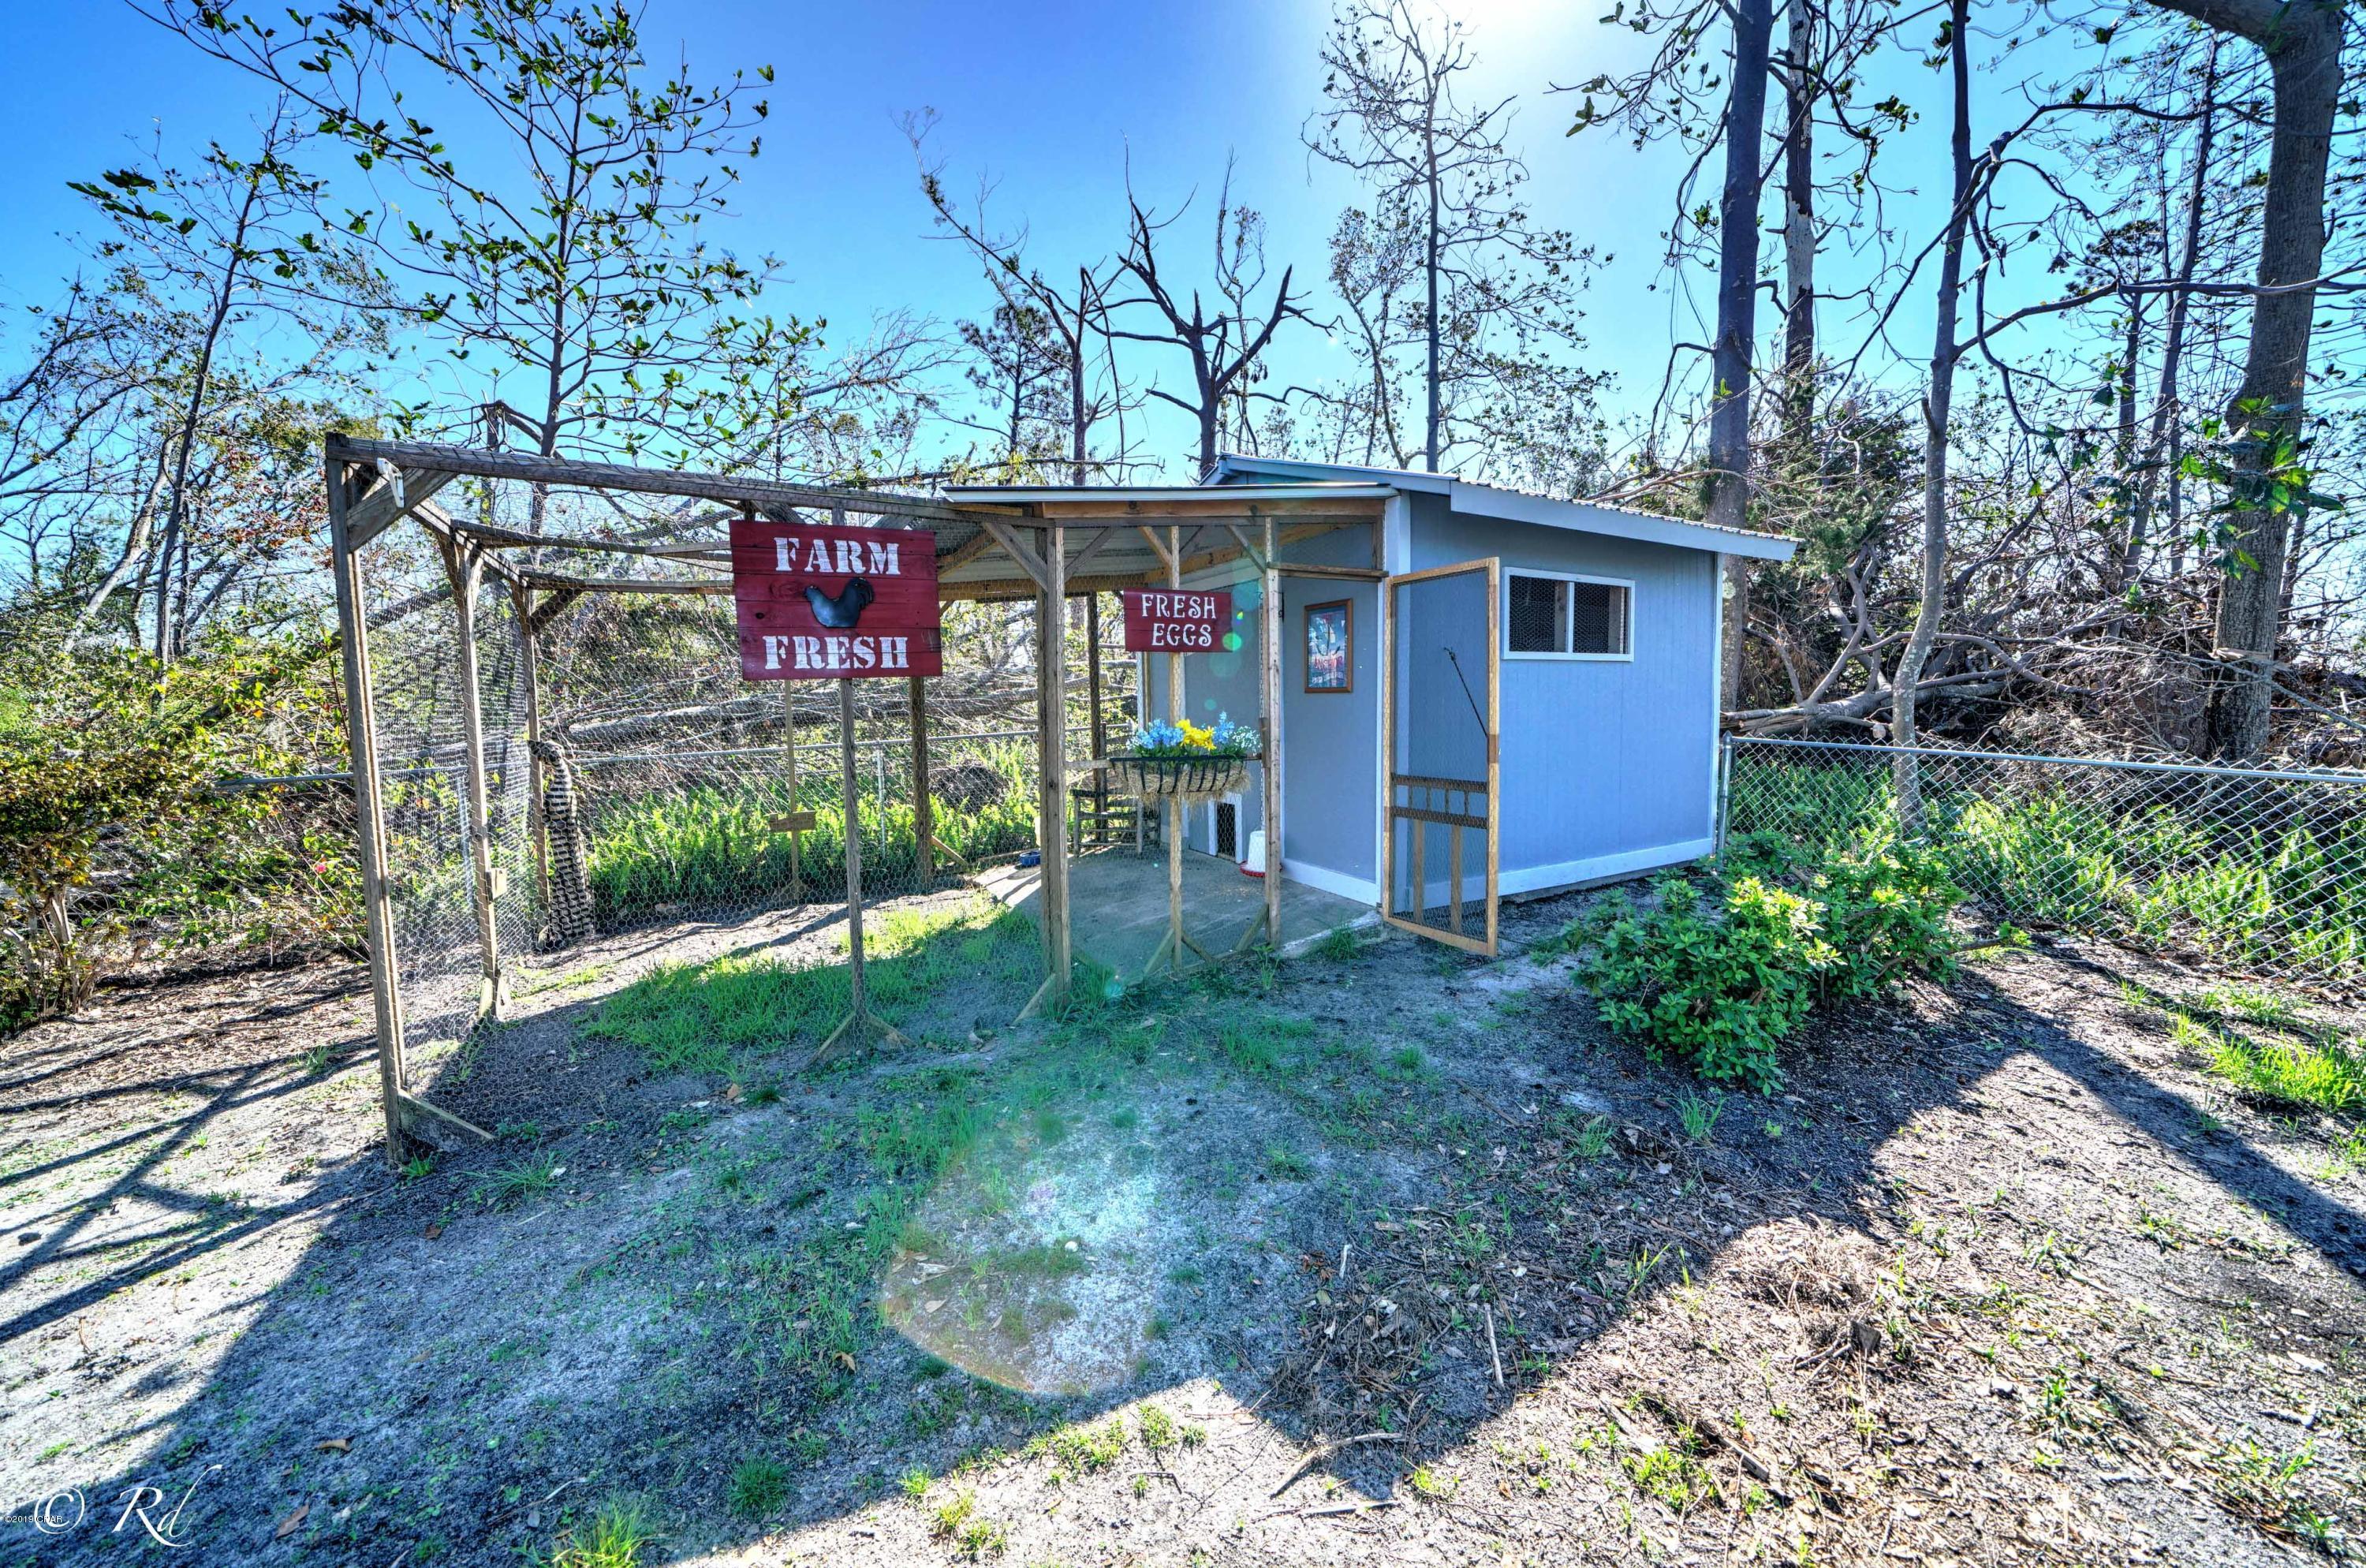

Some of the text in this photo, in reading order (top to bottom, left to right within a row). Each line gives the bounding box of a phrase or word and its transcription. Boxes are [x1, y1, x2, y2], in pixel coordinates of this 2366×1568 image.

[774, 537, 901, 575] FARM
[1142, 594, 1216, 619] FRESH
[1151, 623, 1212, 647] EGGS
[763, 635, 909, 670] FRESH
